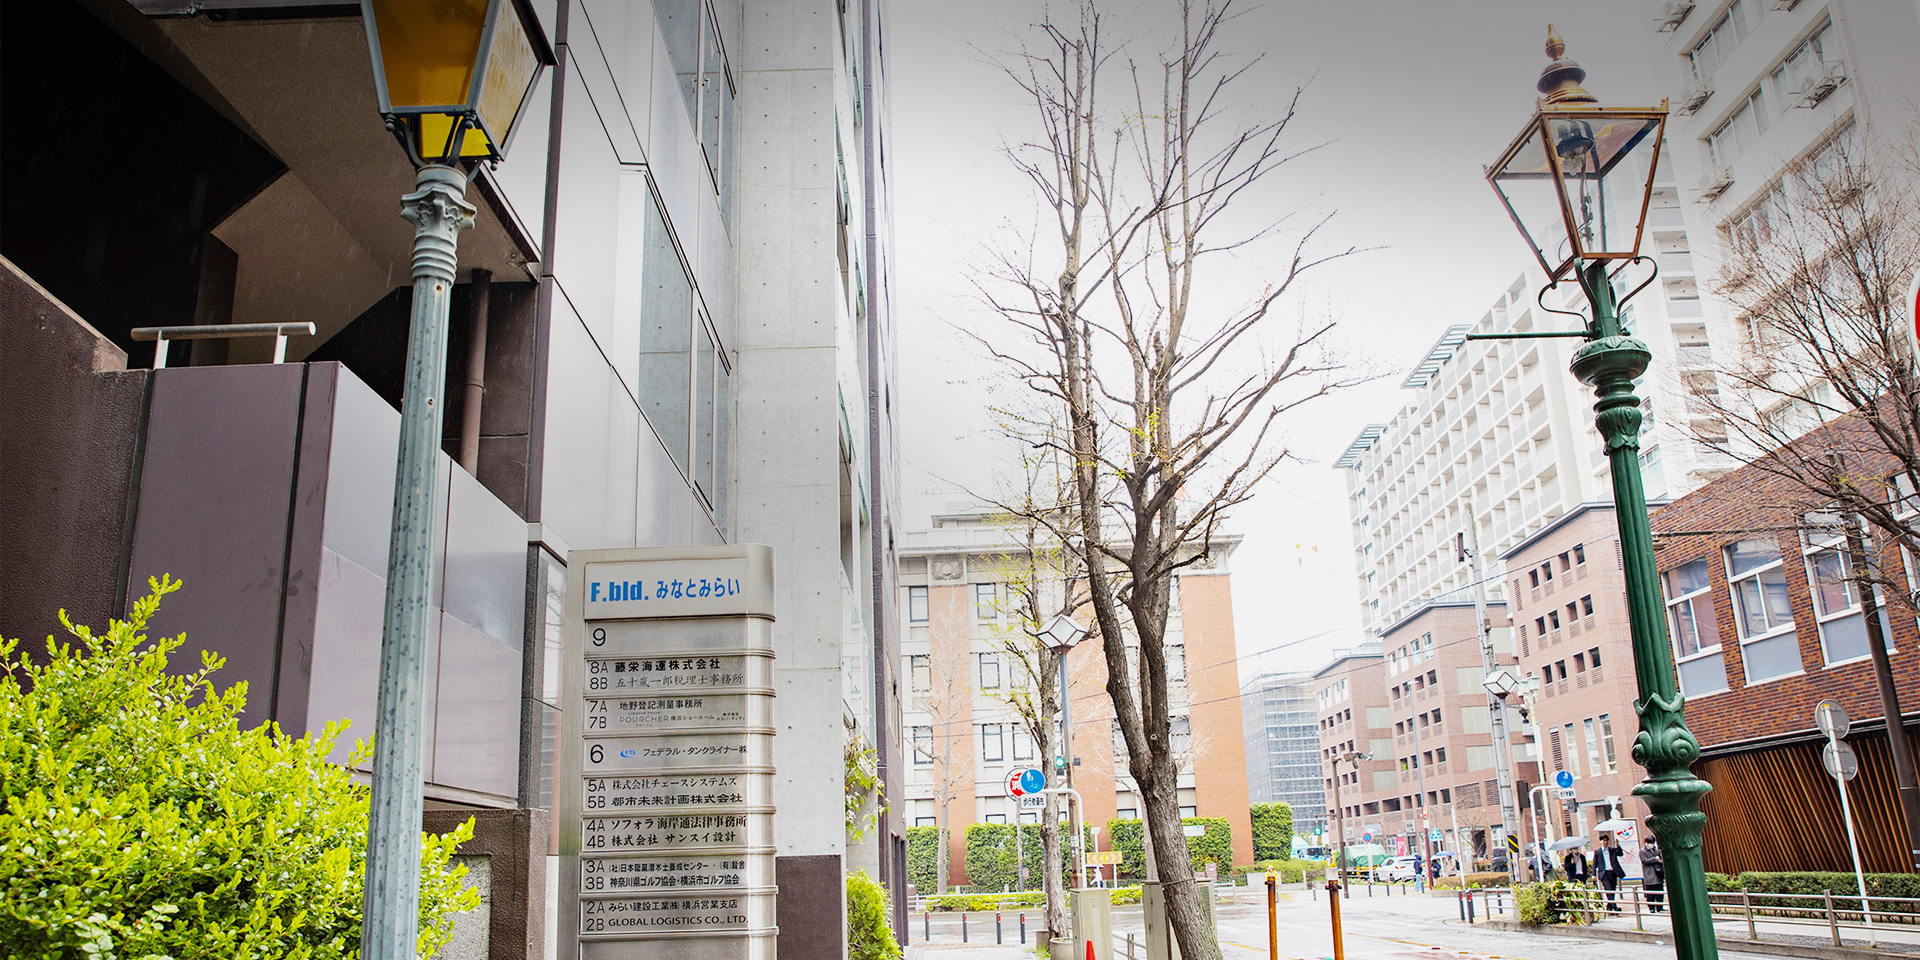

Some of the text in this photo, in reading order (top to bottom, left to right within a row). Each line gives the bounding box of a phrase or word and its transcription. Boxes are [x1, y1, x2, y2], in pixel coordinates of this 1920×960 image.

[591, 577, 740, 602] F.bld. みなとみらい
[592, 627, 606, 647] 9
[590, 658, 721, 674] 8A 藤栄海運株式会社
[590, 673, 744, 690] 8B 五十嵐一郎税理士事務所
[589, 698, 703, 713] 7A 地野登記測量事務所
[589, 716, 607, 729] 7B
[619, 714, 669, 724] POURCHER
[590, 744, 604, 764] 6
[587, 776, 737, 793] 5A 株式会社チェースシステムズ
[587, 793, 743, 809] 5B 都市未来計画株式会社
[586, 819, 605, 832] 4A
[586, 831, 737, 848] 4B 株式会社 サンスイ設計
[585, 860, 605, 874] 3A
[585, 874, 740, 890] 3B 神奈川県ゴルフ協会・横浜市ゴルフ協会
[586, 901, 605, 914] 2A
[682, 899, 738, 910] 横浜営業支店
[586, 915, 749, 931] 2B GLOBAL LOGISTICS CO., LTD.
